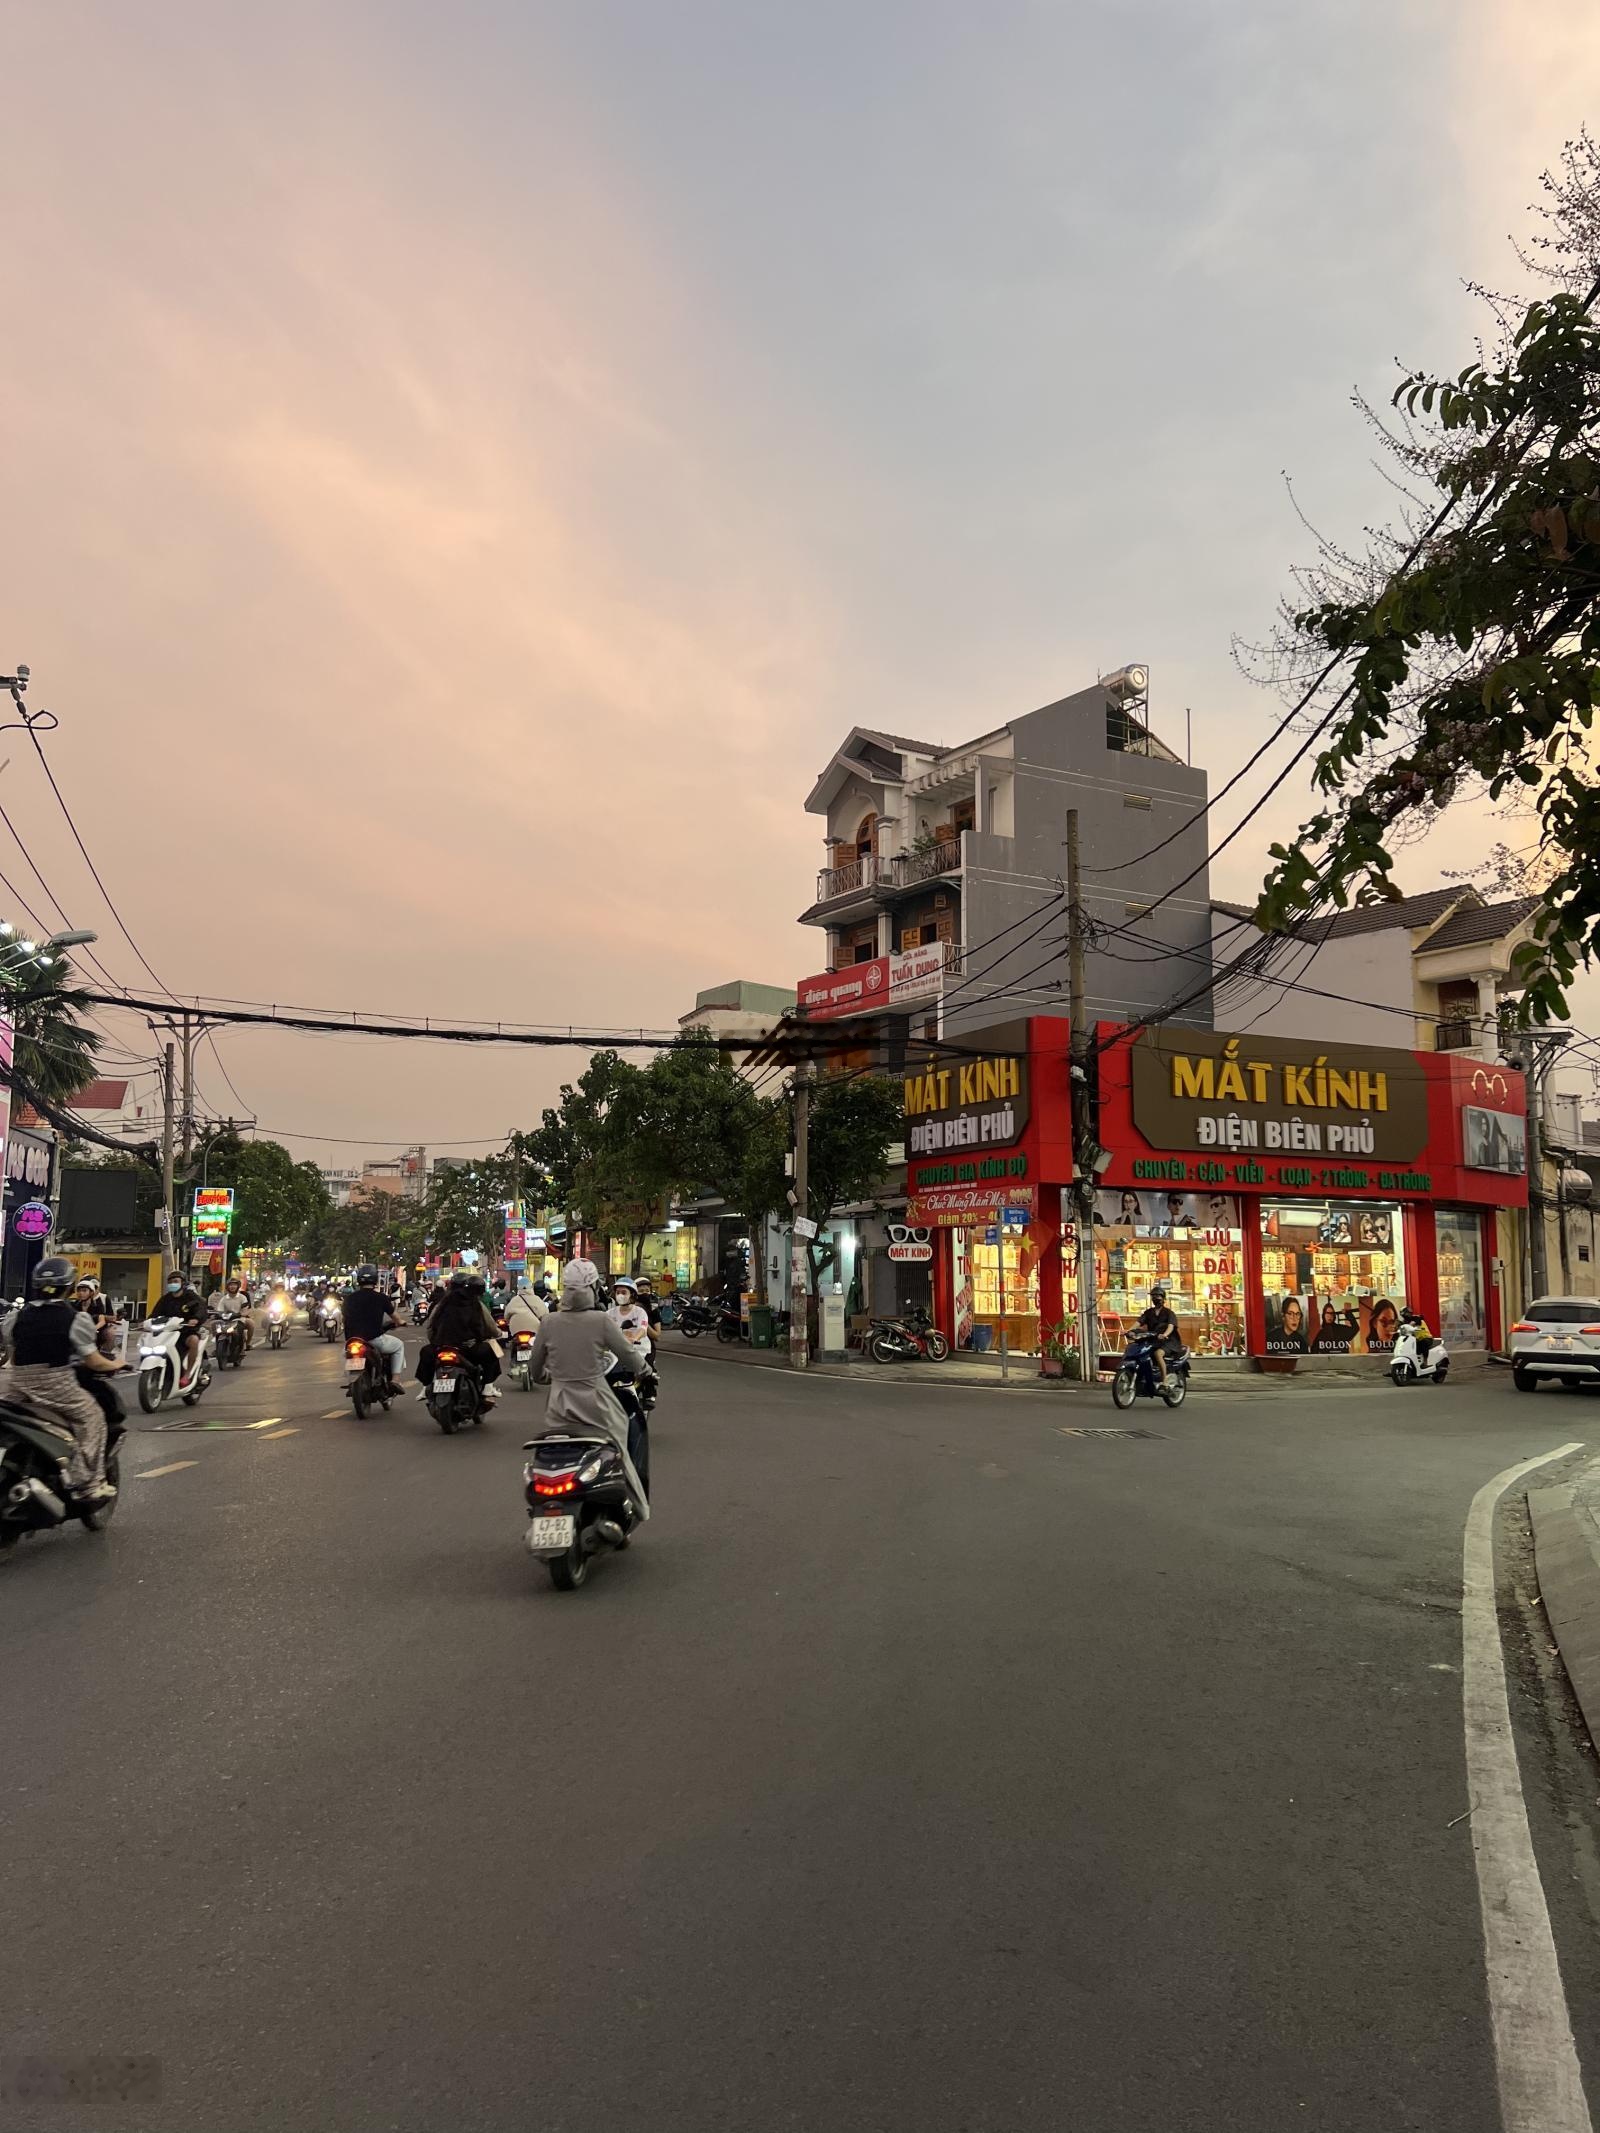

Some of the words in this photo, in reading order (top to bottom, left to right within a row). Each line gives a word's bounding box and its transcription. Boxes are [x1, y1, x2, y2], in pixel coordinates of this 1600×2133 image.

[892, 961, 914, 983] TUẤN
[831, 980, 863, 1003] quang
[960, 1055, 1020, 1106] KÍNH
[1171, 1038, 1273, 1103] MẮT
[1284, 1055, 1389, 1112] KÍNH
[910, 1118, 944, 1155] ĐIỆN
[944, 1112, 979, 1148] BIÊN
[980, 1101, 1015, 1142] PHỦ
[1196, 1112, 1258, 1152] ĐIỆN
[1264, 1116, 1321, 1151] BIÊN
[1326, 1118, 1375, 1154] PHỦ
[958, 1162, 976, 1181] GIA
[980, 1156, 1005, 1179] KÍNH
[1133, 1157, 1187, 1180] CHUYÊN
[1198, 1160, 1225, 1185] CẬN
[1234, 1158, 1265, 1184] VIỄN
[1280, 1167, 1311, 1189] LOẠN
[1009, 1187, 1034, 1206] 2025
[962, 1211, 978, 1224] 20%
[83, 1261, 97, 1269] PIN
[1204, 1253, 1236, 1275] ĐÃI
[1208, 1283, 1233, 1301] HS
[1214, 1306, 1229, 1325] &
[1210, 1331, 1235, 1349] SV
[1266, 1340, 1300, 1350] BOLON
[1319, 1340, 1352, 1350] BOLON
[1369, 1340, 1394, 1349] BOLO
